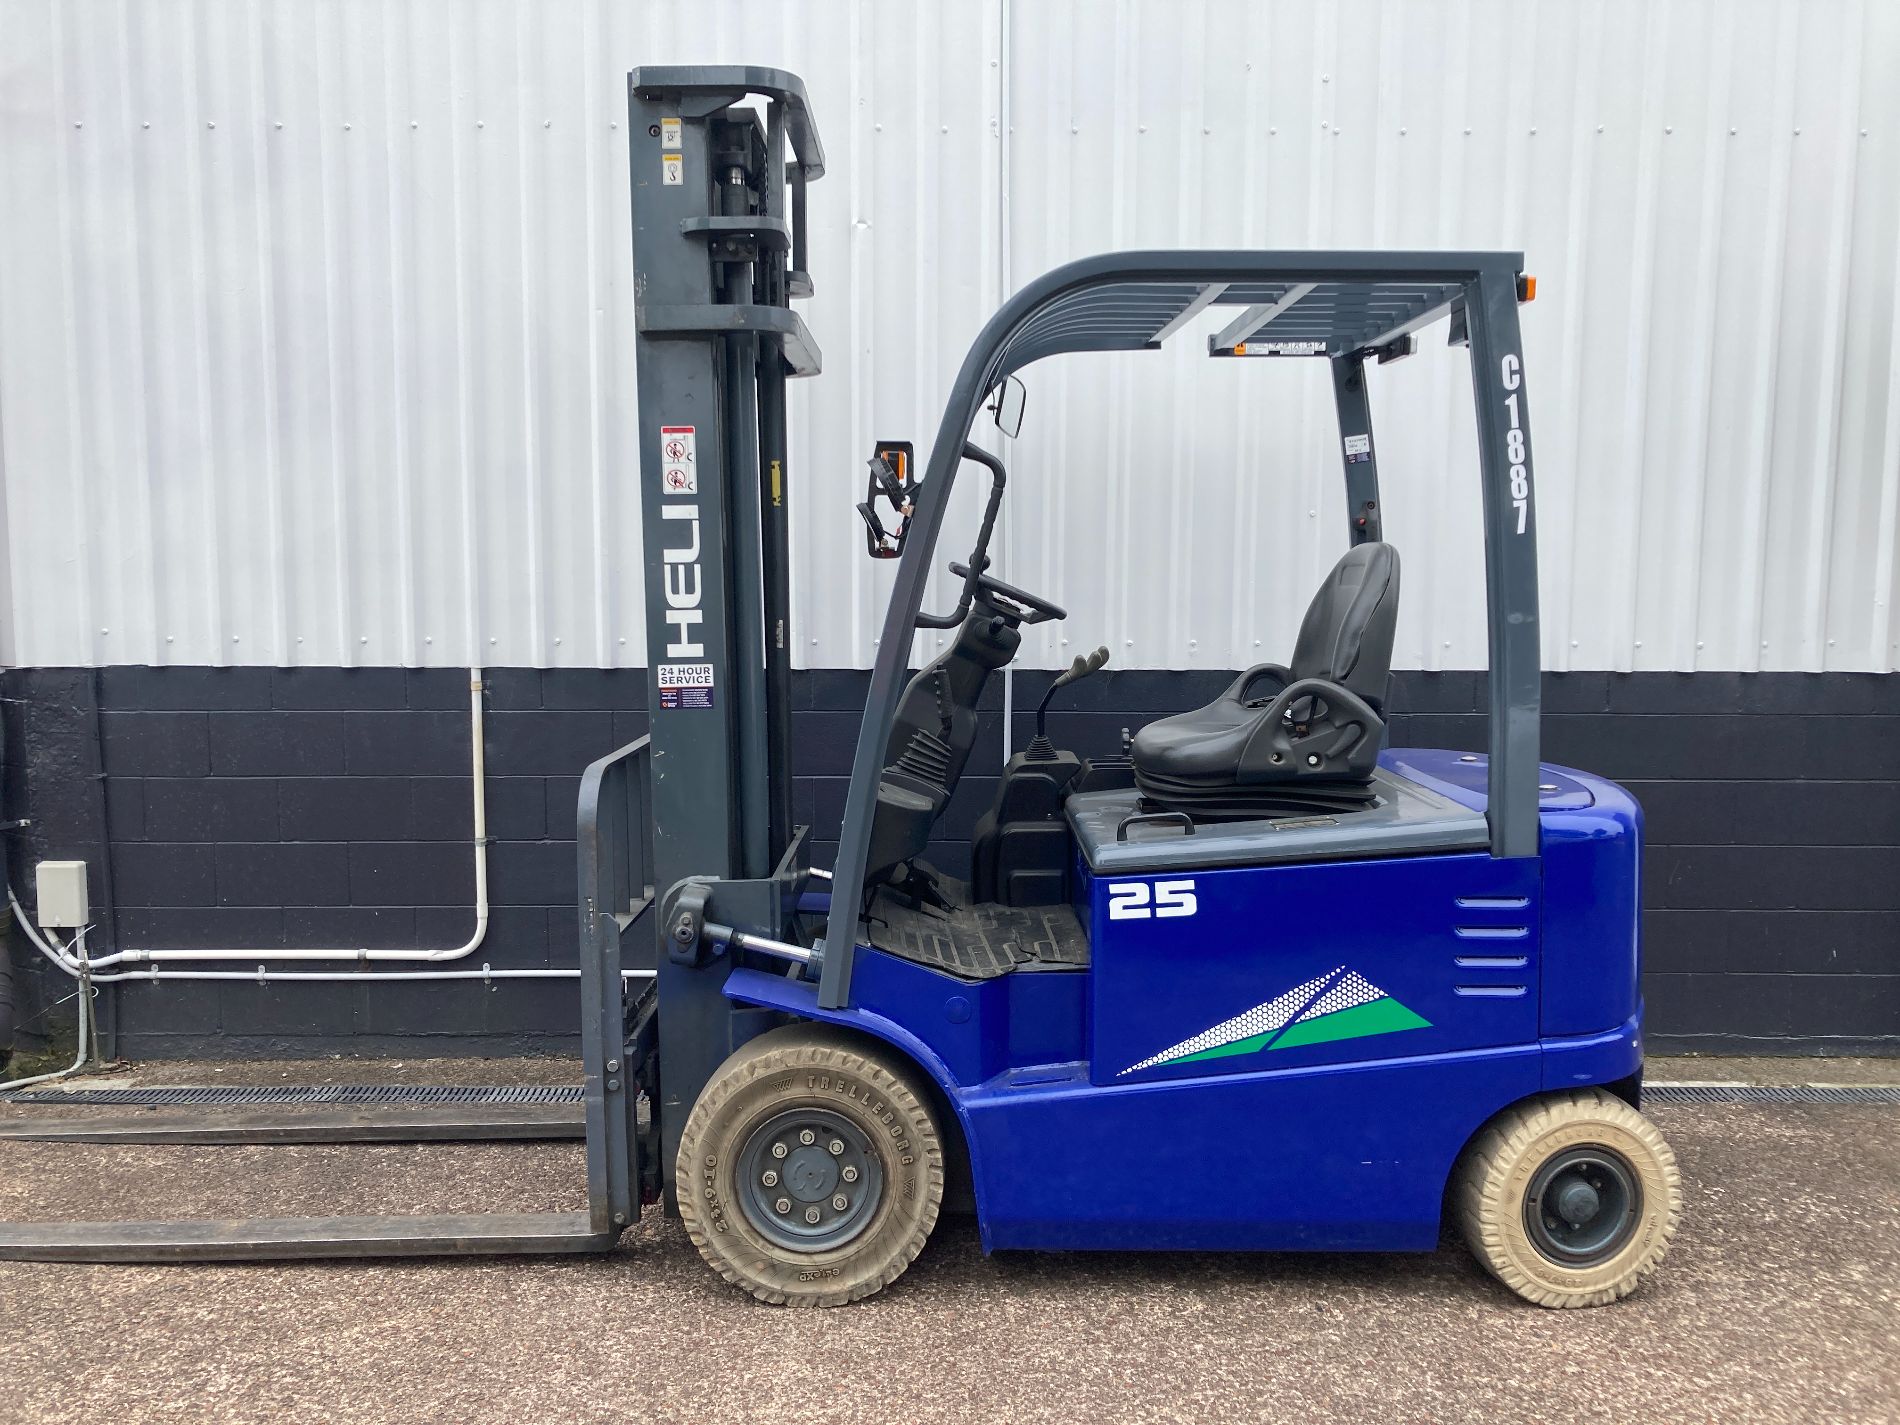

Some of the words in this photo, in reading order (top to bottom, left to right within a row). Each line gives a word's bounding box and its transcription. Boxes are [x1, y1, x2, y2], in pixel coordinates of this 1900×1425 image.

[1501, 354, 1528, 535] C1887
[661, 504, 704, 658] HELI
[660, 667, 674, 675] 24
[678, 666, 711, 675] HOUR
[660, 675, 711, 685] SERVICE
[1109, 880, 1197, 920] 25
[807, 1075, 914, 1165] TRELLEBORG
